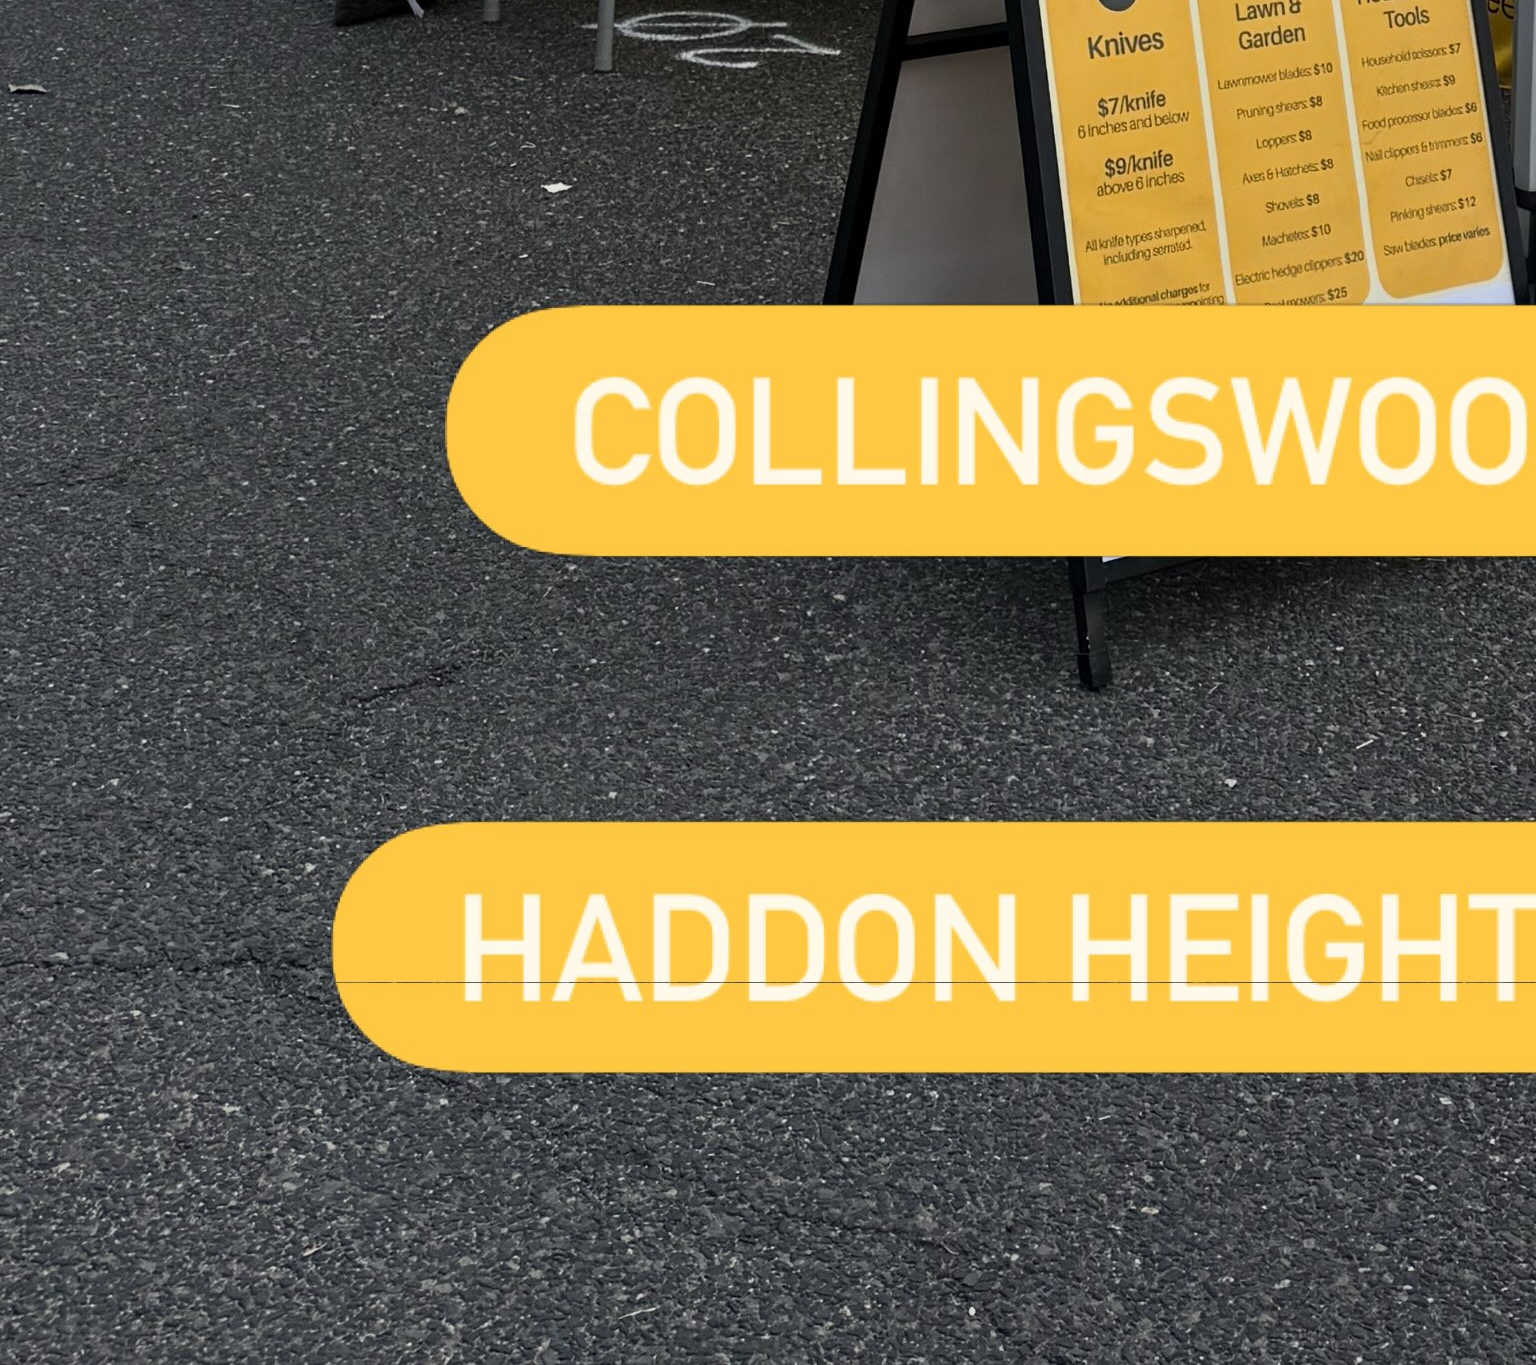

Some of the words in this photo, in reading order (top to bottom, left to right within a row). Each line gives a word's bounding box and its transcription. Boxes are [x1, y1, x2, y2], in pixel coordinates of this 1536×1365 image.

[1235, 0, 1285, 22] Lawn
[1383, 6, 1430, 29] Tools
[1087, 31, 1165, 59] Knives
[1238, 25, 1306, 50] Garden
[1361, 51, 1411, 69] Household
[1448, 42, 1461, 55] $7
[1217, 71, 1277, 90] Lawnmower
[1313, 62, 1333, 76] $10
[1376, 83, 1410, 98] Kitchen
[1443, 74, 1456, 87] $9
[1097, 90, 1166, 118] $7/knife
[1236, 103, 1274, 120] Pruning
[1309, 95, 1323, 109] $8
[1077, 125, 1086, 139] 6
[1088, 120, 1128, 138] inches
[1129, 114, 1152, 130] and
[1154, 111, 1190, 127] below
[1362, 118, 1386, 131] Food
[1387, 111, 1431, 129] processor
[1299, 129, 1312, 143] $8
[1365, 150, 1383, 163] Nail
[1384, 144, 1420, 161] clippers
[1421, 141, 1428, 153] &
[1470, 132, 1483, 145] $6
[1104, 149, 1174, 178] $9/knife
[1242, 171, 1265, 185] Axes
[1266, 168, 1274, 181] &
[1320, 158, 1334, 172] $8
[1440, 168, 1452, 182] $7
[1096, 178, 1134, 197] above
[1135, 176, 1144, 190] 6
[1145, 170, 1185, 188] inches
[1306, 193, 1320, 207] $8
[1390, 206, 1425, 222] Pinking
[1457, 196, 1477, 210] $12
[1085, 239, 1098, 253] All
[1099, 234, 1124, 251] knife
[1125, 229, 1153, 247] types
[1311, 223, 1331, 238] $10
[1383, 244, 1405, 257] Saw
[1438, 231, 1463, 247] price
[1463, 225, 1491, 240] varies
[1103, 247, 1151, 266] including
[1235, 269, 1271, 286] Electric
[1271, 263, 1303, 281] hedge
[1344, 250, 1365, 265] $20
[1160, 286, 1198, 300] charges
[1198, 282, 1210, 292] for
[1327, 287, 1347, 301] $25
